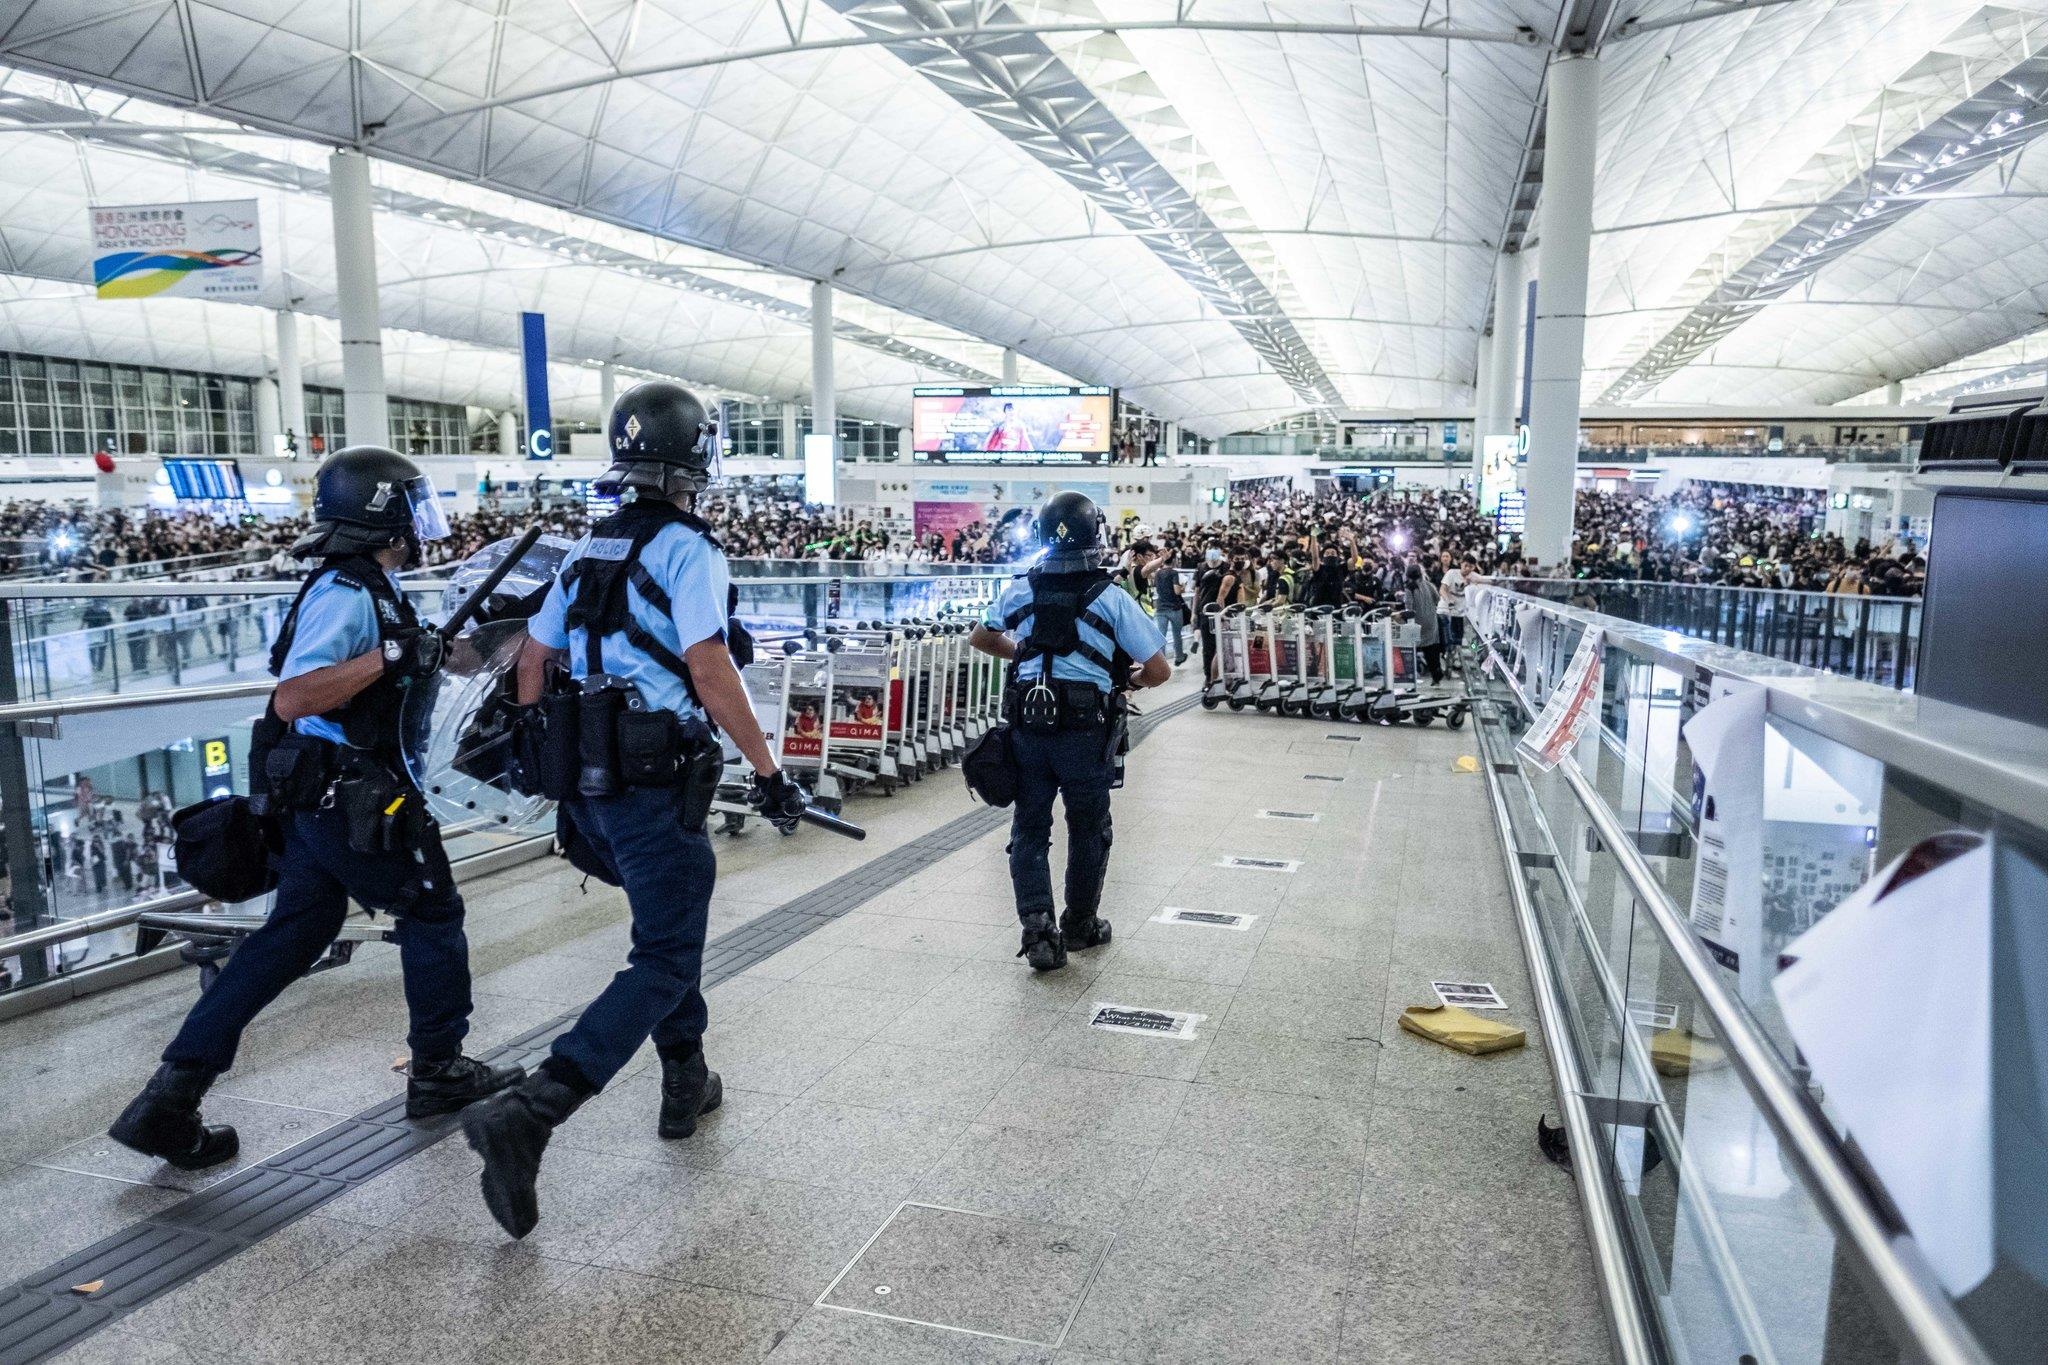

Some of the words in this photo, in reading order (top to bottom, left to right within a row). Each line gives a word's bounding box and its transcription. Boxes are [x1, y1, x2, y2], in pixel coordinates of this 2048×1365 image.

[95, 225, 139, 239] HONG
[141, 223, 187, 236] KONG
[129, 239, 162, 248] WORLD
[530, 429, 552, 457] C
[615, 437, 630, 450] C4
[1519, 424, 1531, 456] D
[590, 542, 626, 557] POLICE
[849, 728, 879, 737] QIMA
[205, 741, 228, 767] B
[789, 742, 821, 751] QIMA
